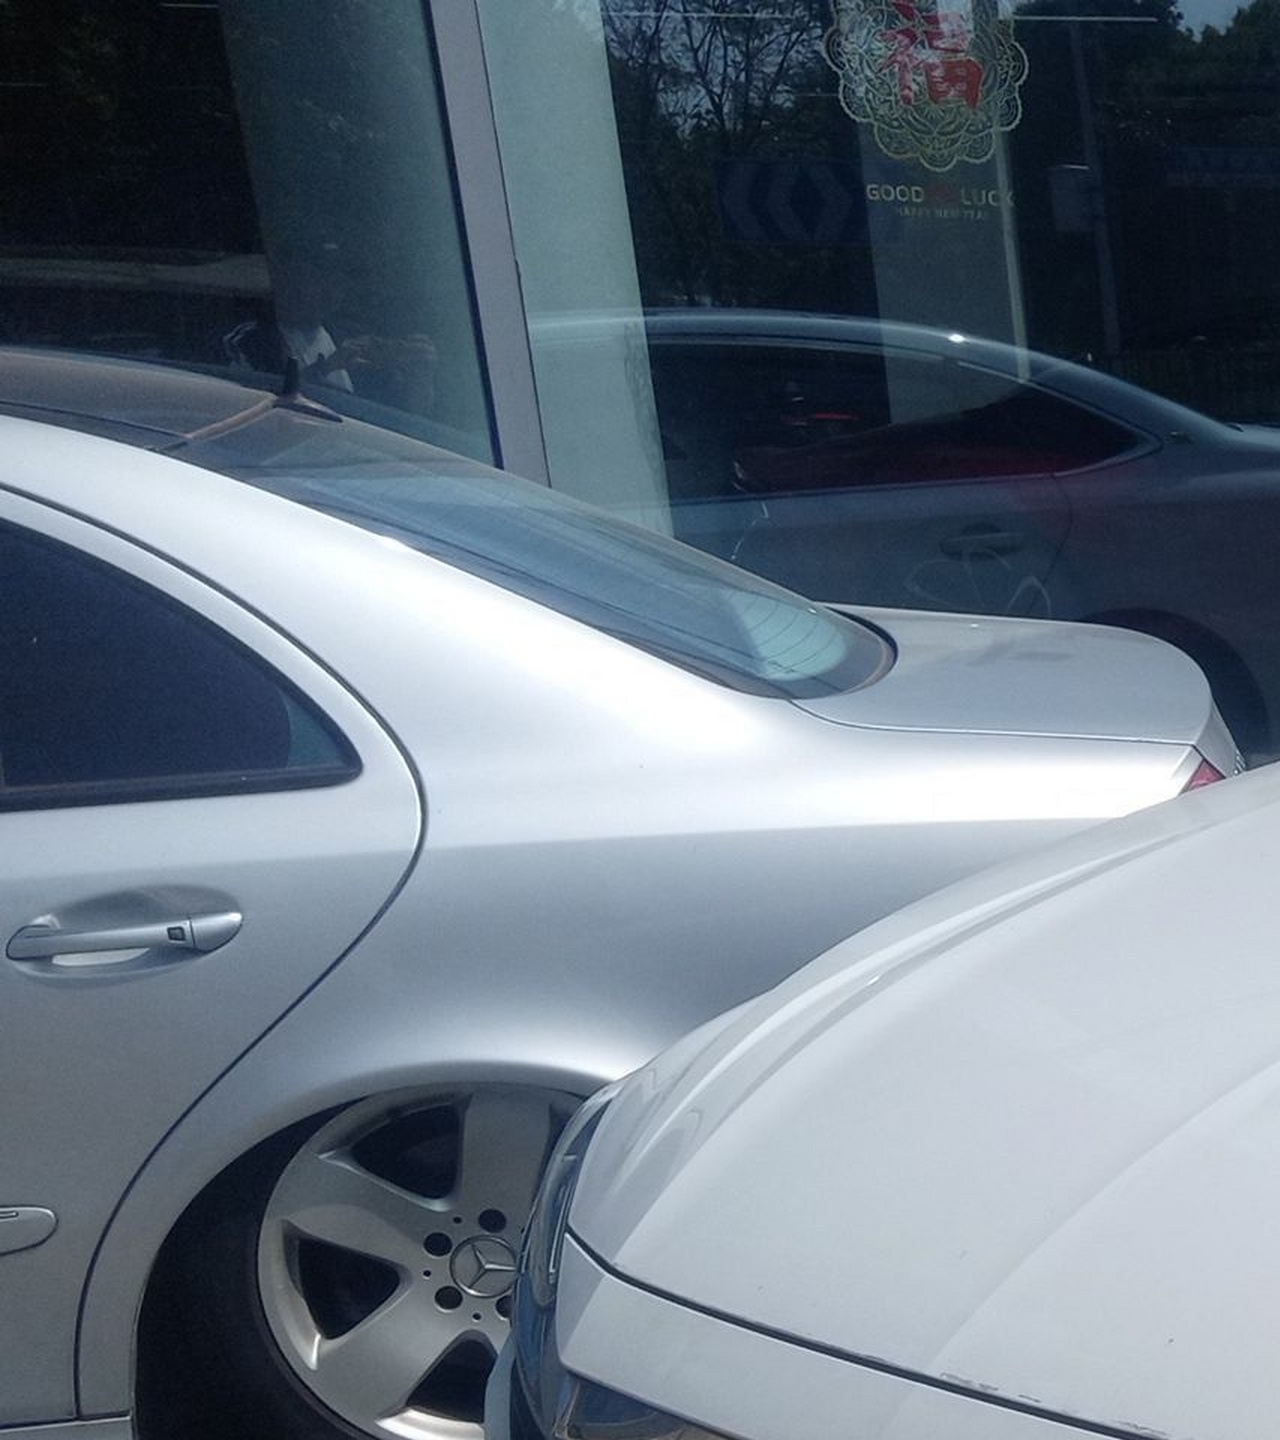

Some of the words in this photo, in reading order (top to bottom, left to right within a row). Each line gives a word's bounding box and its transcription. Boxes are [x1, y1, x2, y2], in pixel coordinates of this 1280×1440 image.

[877, 0, 984, 109] 福
[865, 184, 925, 203] GOOD
[960, 188, 1014, 207] LUCK
